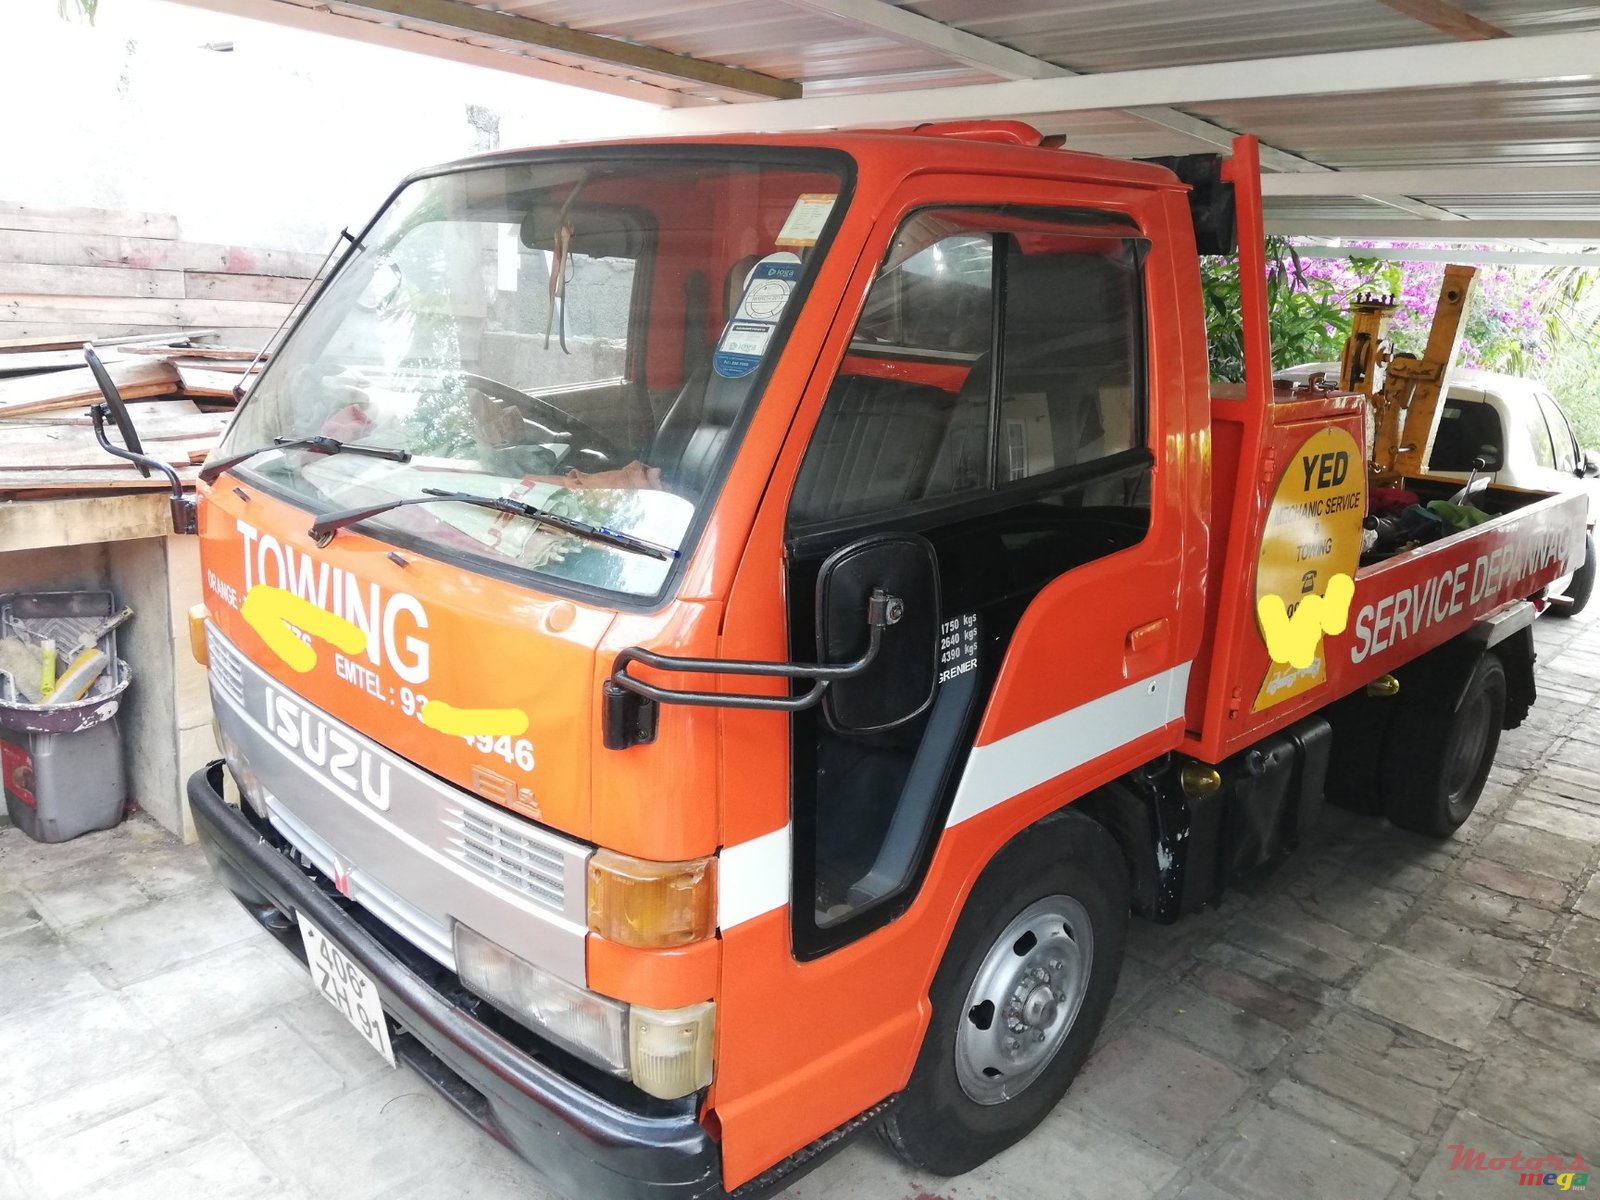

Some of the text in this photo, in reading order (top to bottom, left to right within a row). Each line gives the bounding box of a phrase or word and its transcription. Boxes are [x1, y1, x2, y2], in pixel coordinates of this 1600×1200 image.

[1302, 450, 1349, 491] YED
[1325, 492, 1361, 515] SERVICE
[1296, 538, 1332, 562] TOWING
[207, 568, 238, 610] ORANGE
[236, 518, 430, 684] TOWING
[941, 618, 960, 635] 1750
[1351, 562, 1469, 664] SERVICE
[941, 633, 960, 650] 2640
[941, 647, 960, 663] 4390
[265, 685, 391, 812] ISUZU
